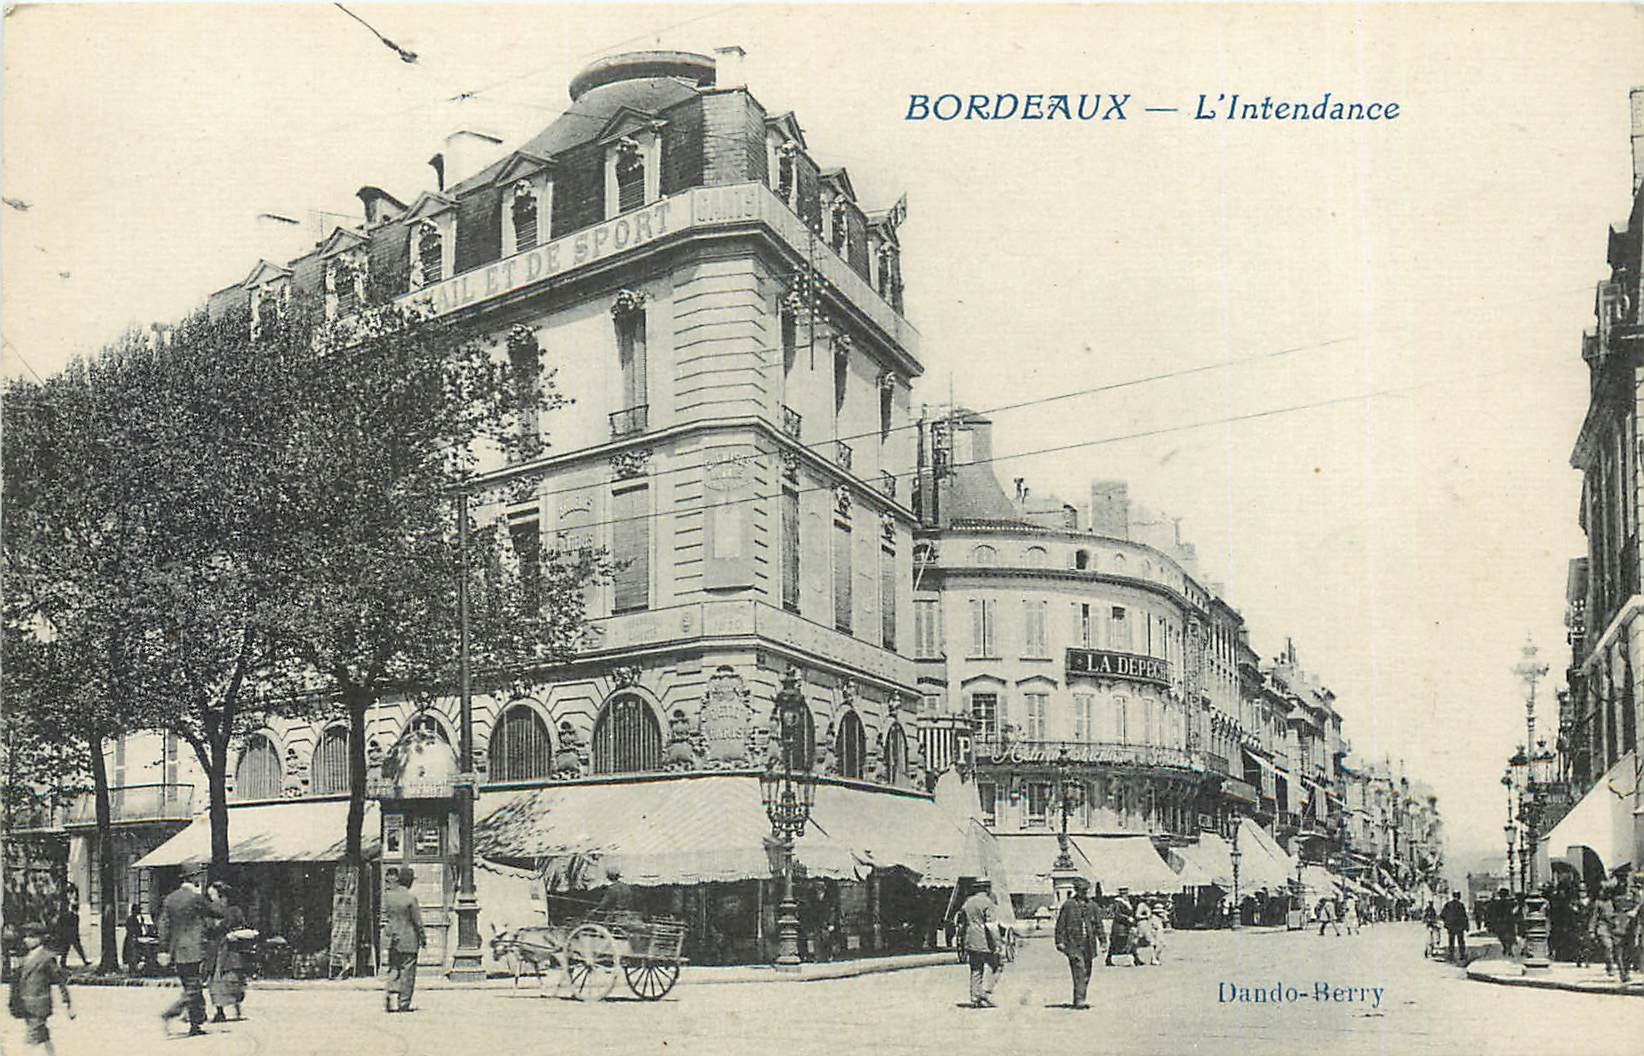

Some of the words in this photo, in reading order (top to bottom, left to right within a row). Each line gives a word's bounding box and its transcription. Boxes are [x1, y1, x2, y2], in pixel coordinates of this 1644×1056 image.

[486, 260, 518, 291] ET
[528, 241, 560, 277] DE
[573, 203, 672, 263] SPORT
[1087, 654, 1111, 672] LA
